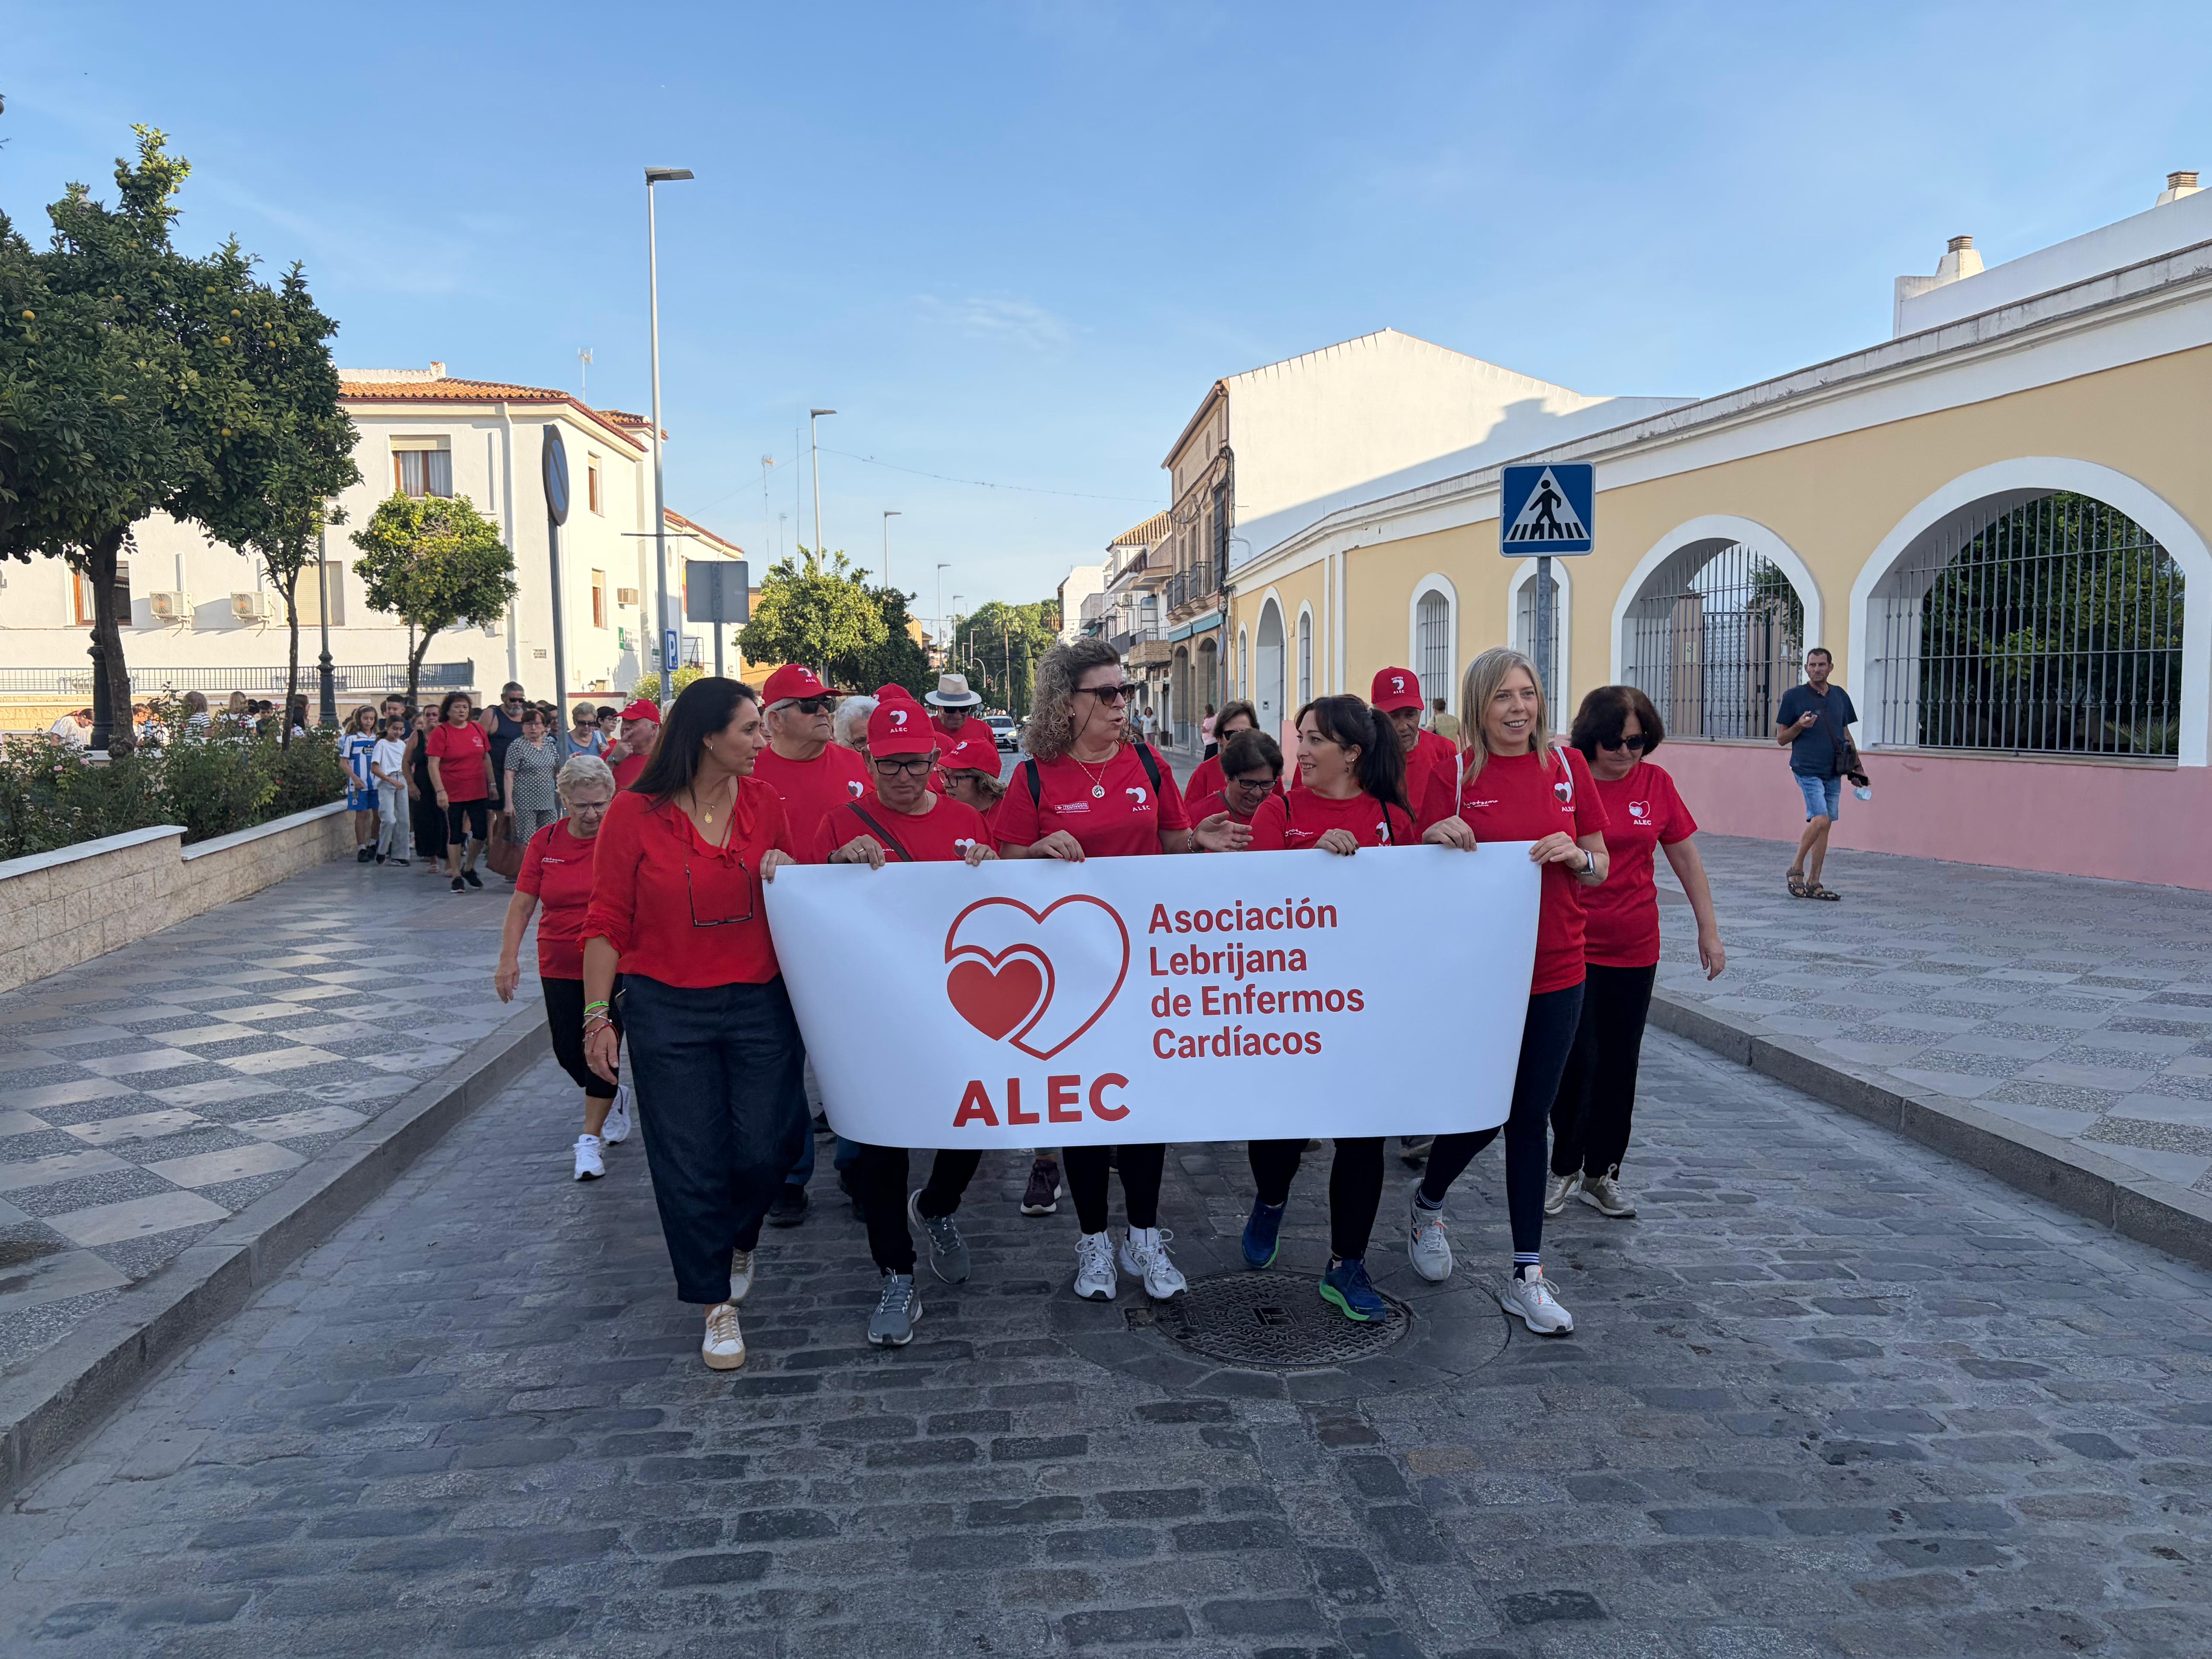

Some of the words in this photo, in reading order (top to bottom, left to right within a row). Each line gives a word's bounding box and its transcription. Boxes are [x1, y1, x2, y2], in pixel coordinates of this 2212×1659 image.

[668, 633, 676, 667] P
[1148, 896, 1338, 934] Asociación
[1149, 942, 1307, 981] Lebrijana
[1151, 987, 1191, 1018] de
[1201, 983, 1365, 1016] Enfermos
[1153, 1024, 1322, 1059] Cardíacos
[953, 1072, 1131, 1128] ALEC
[1221, 1292, 1283, 1307] HUESNA
[1221, 1321, 1309, 1342] CONSORCIO
